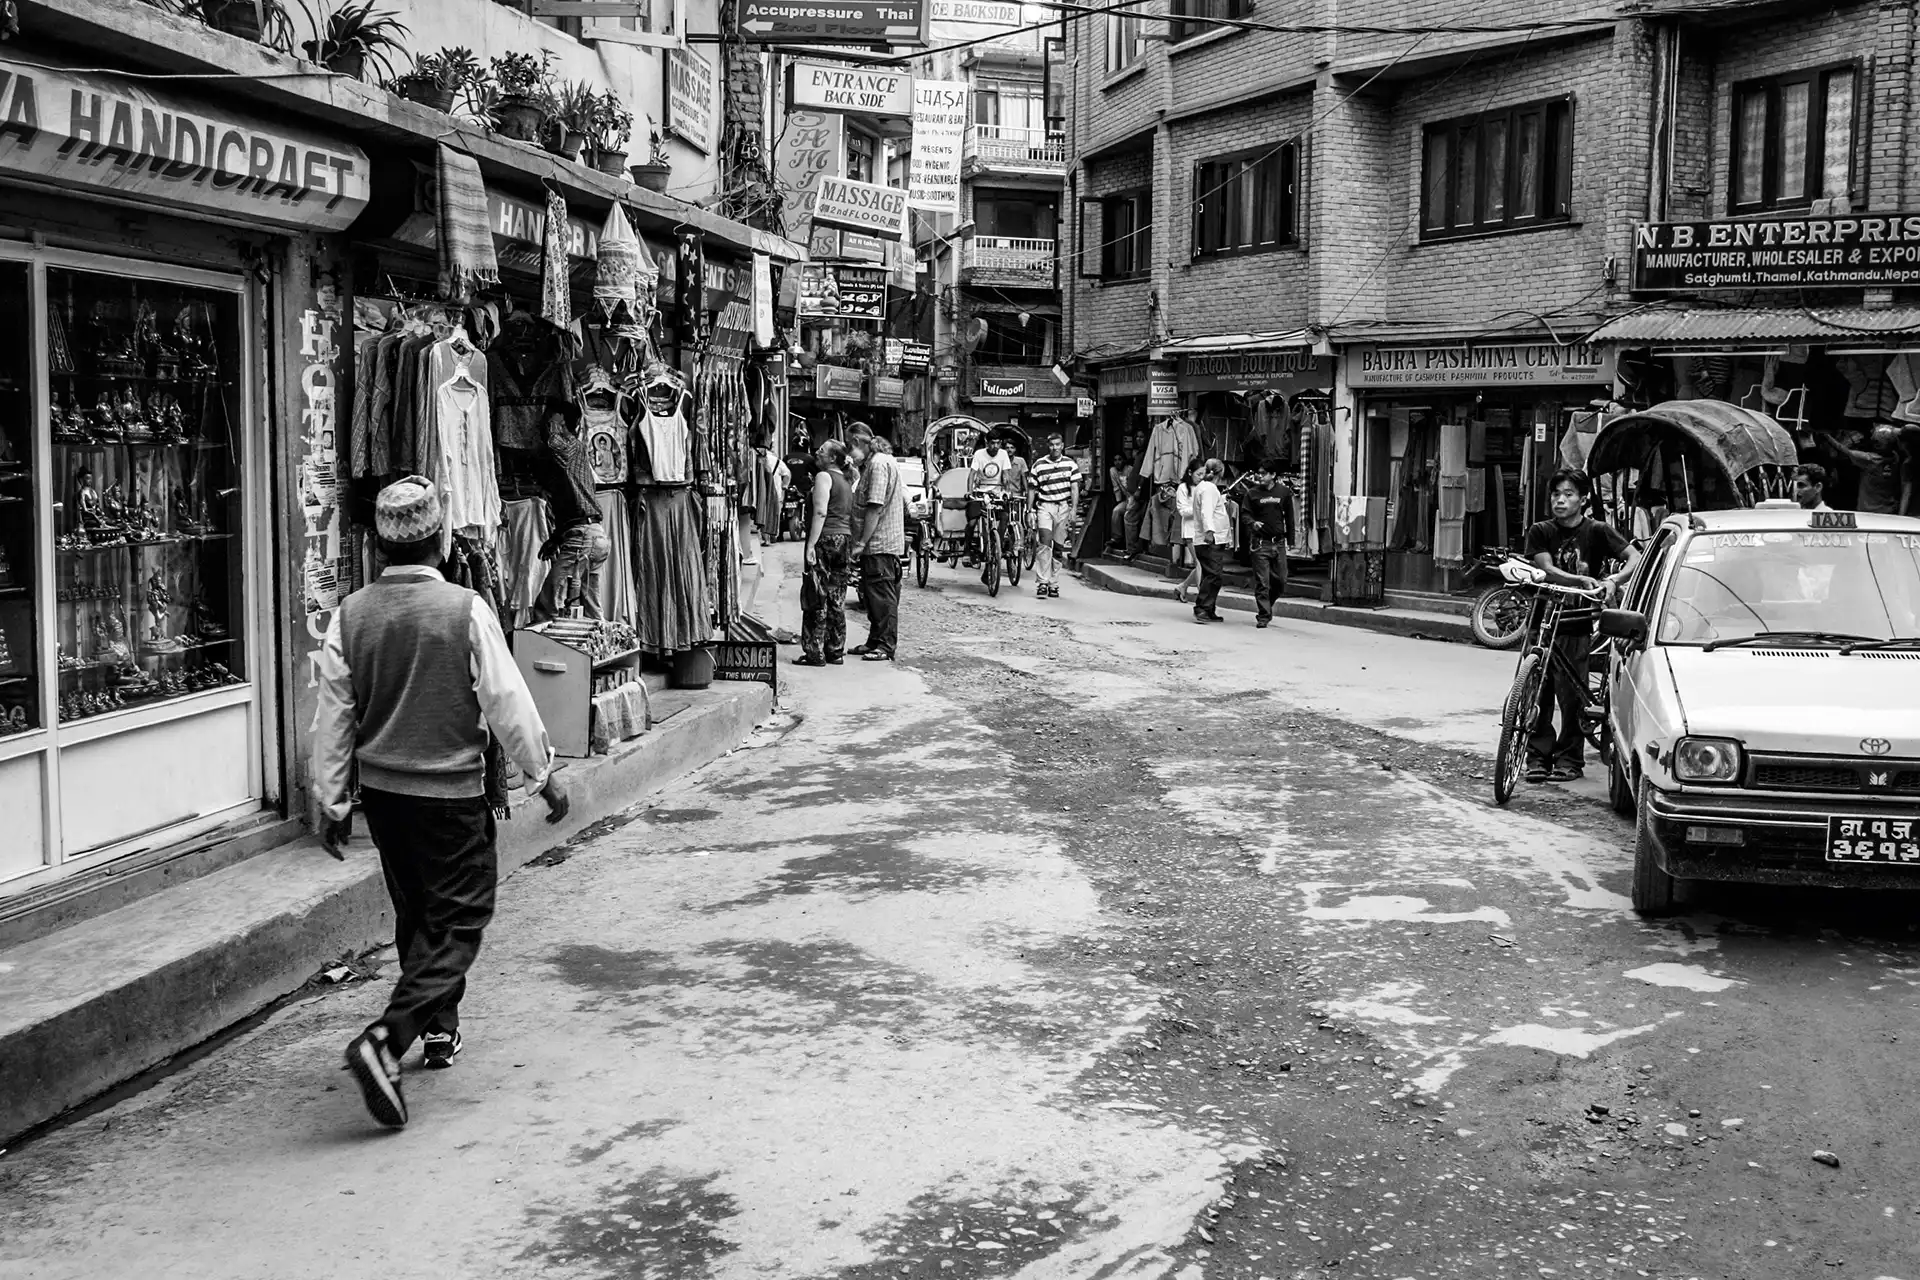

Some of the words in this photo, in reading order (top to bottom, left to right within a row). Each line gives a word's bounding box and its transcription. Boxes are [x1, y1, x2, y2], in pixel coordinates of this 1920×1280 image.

[746, 4, 863, 19] Accupressure
[877, 8, 914, 20] Thai
[953, 4, 1015, 20] BACKSIDE
[773, 22, 816, 33] 2nd
[825, 24, 886, 35] Floor
[671, 60, 710, 114] MASSAGE
[812, 70, 899, 94] ENTRANCE
[824, 90, 857, 105] BACK
[858, 93, 886, 108] SIDE
[915, 89, 965, 110] LHASA
[57, 89, 355, 213] HANDICRAFT
[921, 145, 952, 154] PRESENTS
[821, 181, 905, 214] MASSAGE
[831, 207, 847, 216] 2nd
[849, 211, 887, 224] FLOOR
[1671, 226, 1700, 248] B.
[1708, 217, 1920, 248] ENTERPRIS
[1848, 249, 1862, 264] &
[1869, 246, 1920, 264] EXPO
[1186, 357, 1232, 376] DRAGON
[1240, 353, 1318, 373] BOUTIQUE
[1362, 350, 1417, 372] BAJRA
[1425, 348, 1518, 370] PASHMINA
[1525, 346, 1605, 367] CENTRE
[1364, 373, 1403, 383] MANUFACTURE
[1405, 373, 1412, 382] OF
[1414, 372, 1446, 382] CASHMERE
[1450, 372, 1488, 381] PASHMINA
[1493, 371, 1534, 381] PRODUCTS
[1156, 386, 1174, 394] VISA
[1813, 512, 1854, 527] TAXI
[1708, 534, 1757, 548] TAXI
[1799, 534, 1851, 548] TAXI
[715, 646, 773, 668] MASSAGE
[725, 671, 740, 680] THIS
[741, 672, 755, 680] WAY
